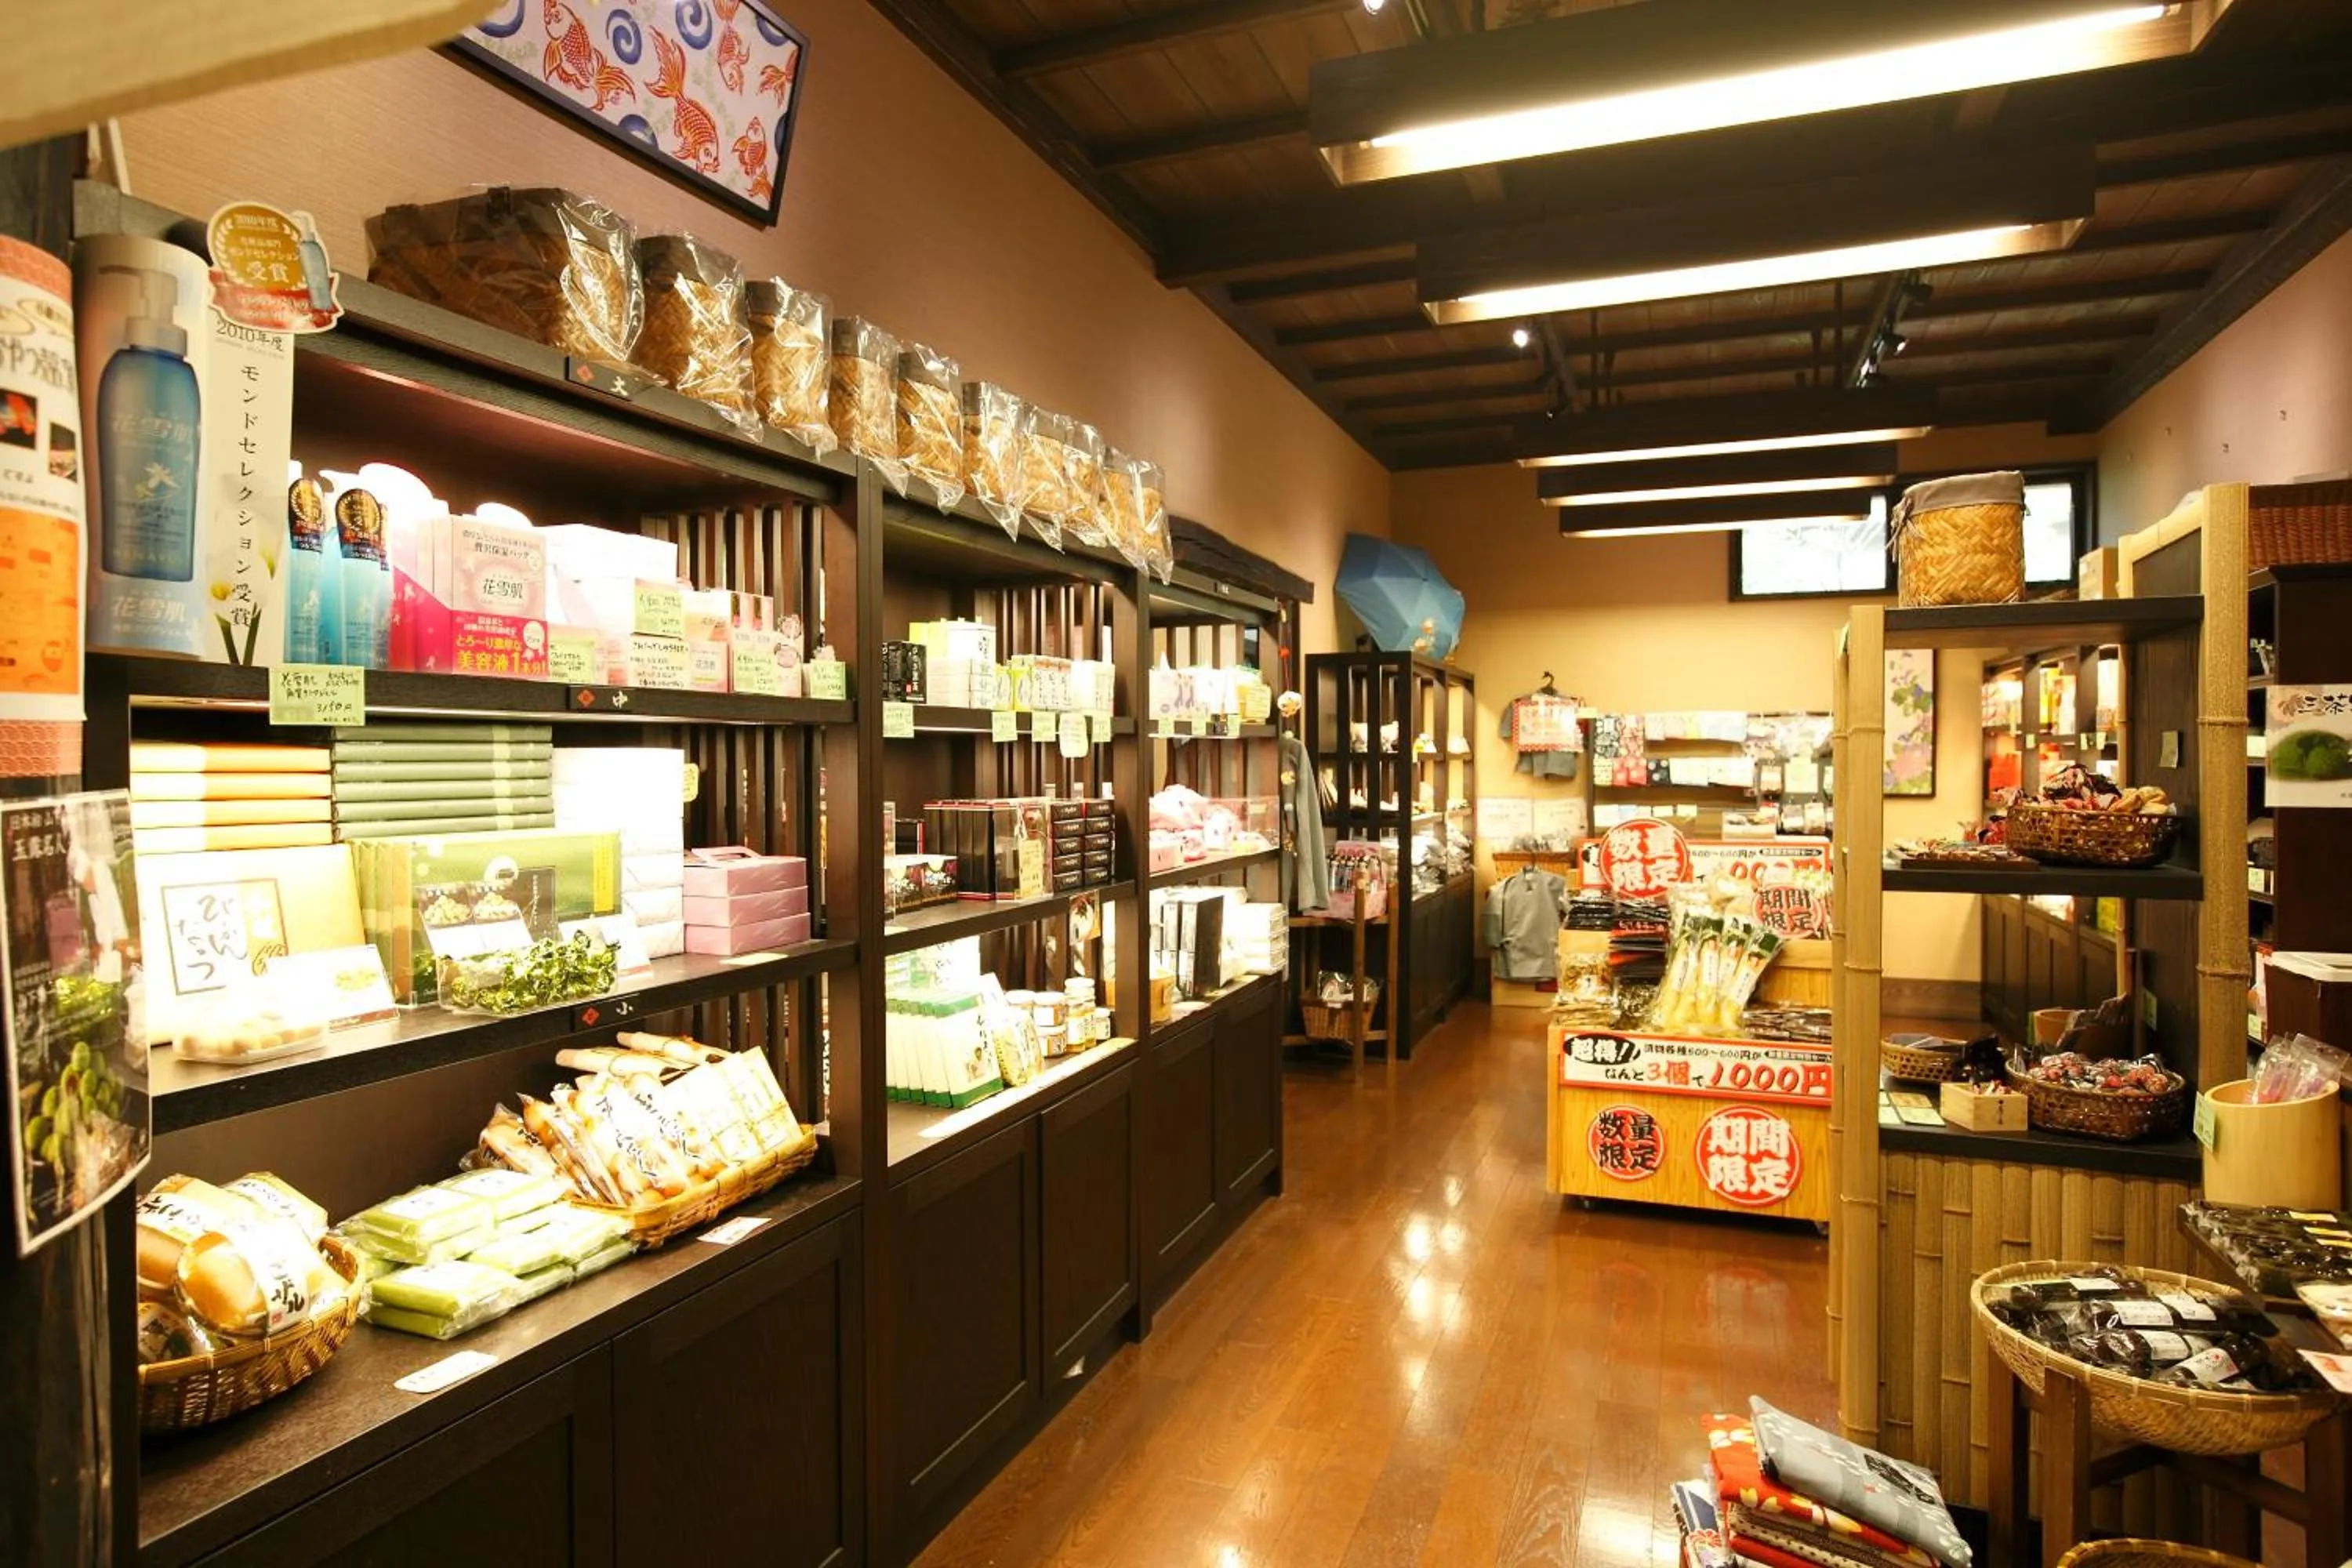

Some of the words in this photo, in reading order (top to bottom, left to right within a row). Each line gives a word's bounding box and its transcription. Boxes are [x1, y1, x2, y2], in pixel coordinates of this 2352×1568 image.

[246, 261, 289, 283] 受賞
[216, 320, 284, 352] 2010年度
[230, 364, 262, 628] モンドセレクション受賞
[483, 578, 524, 600] 花雪肌
[113, 596, 186, 623] 花雪肌
[612, 690, 629, 710] 中
[1609, 826, 1679, 859] 数量
[1610, 859, 1682, 891] 限定
[1760, 890, 1811, 909] 期間
[1763, 911, 1813, 931] 限定
[1599, 1112, 1655, 1143] 数量
[1708, 1116, 1791, 1156] 期間
[1599, 1143, 1657, 1172] 限定
[1708, 1156, 1791, 1196] 限定
